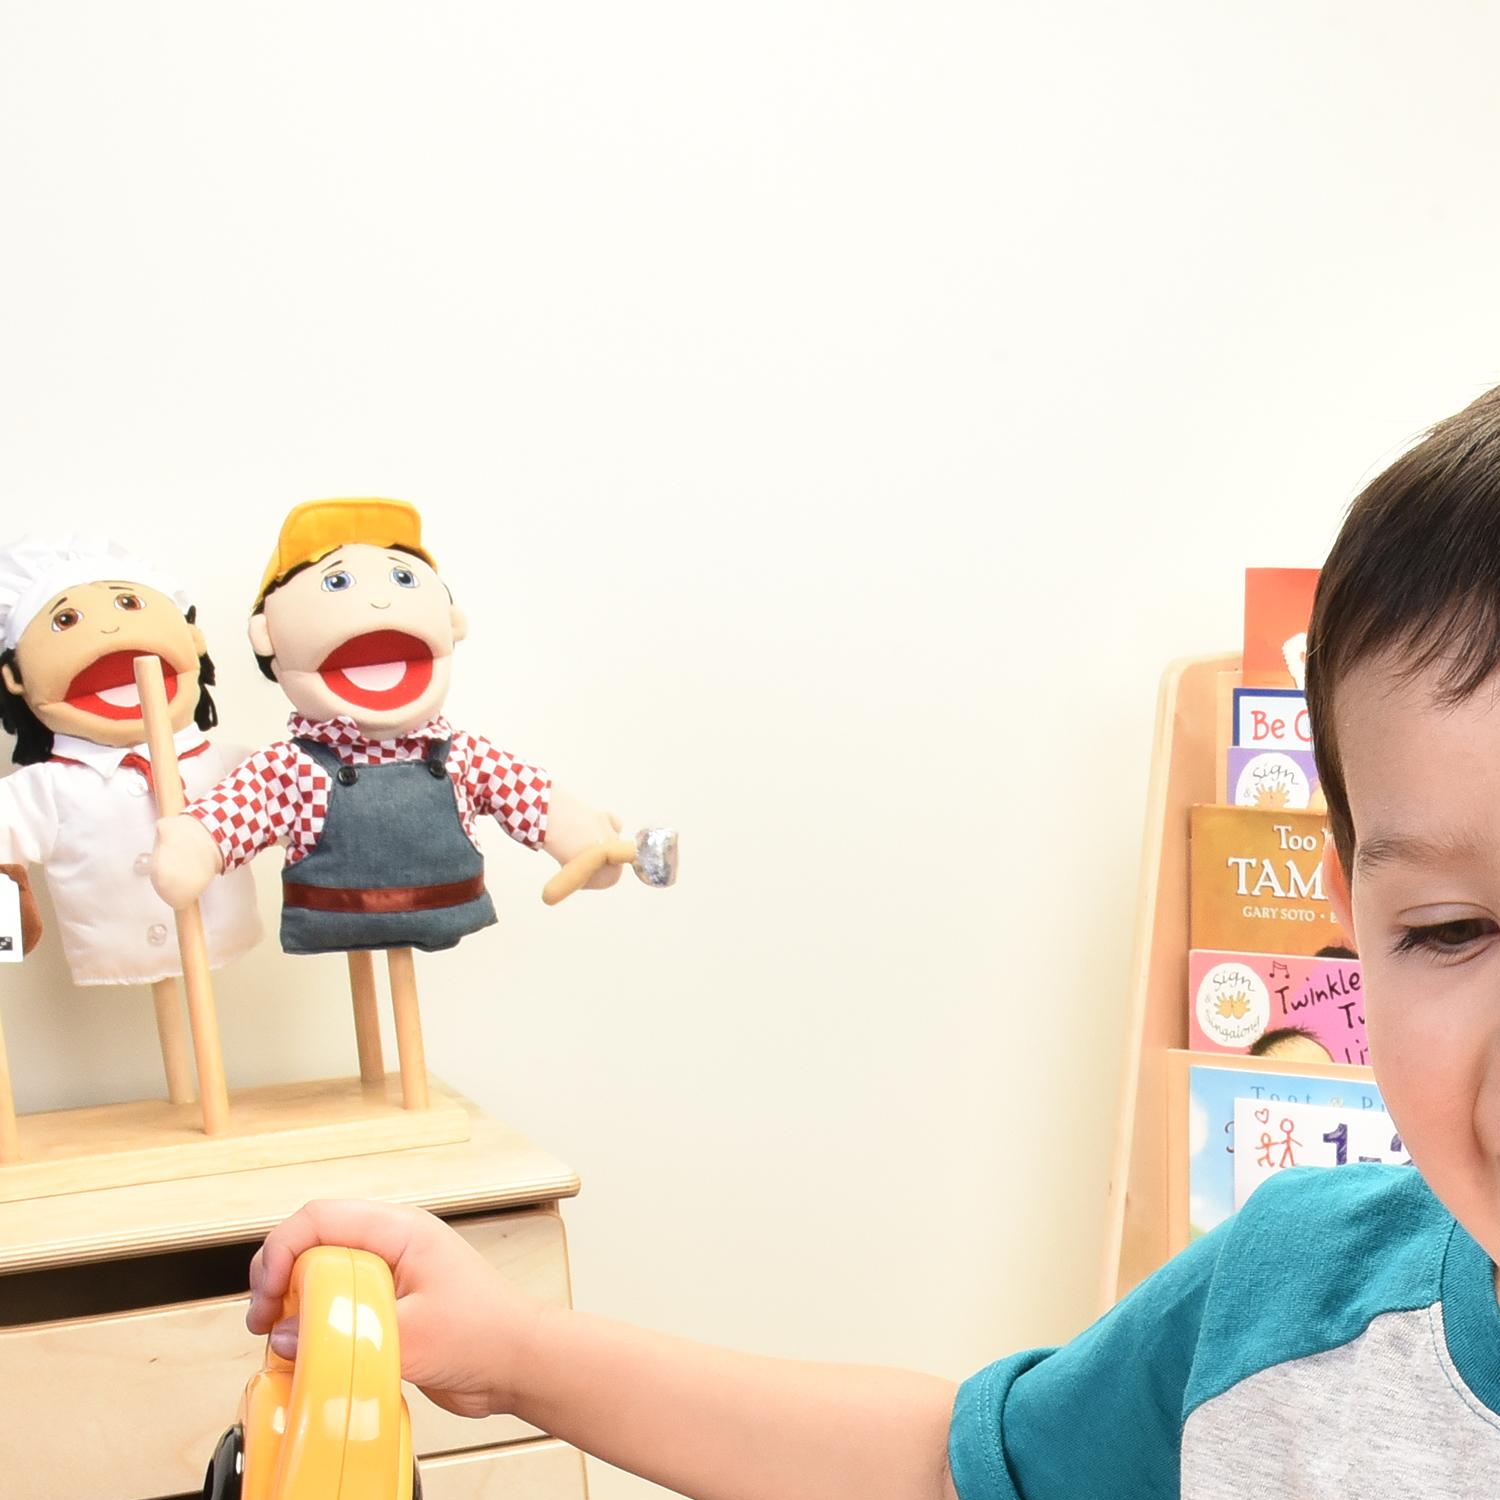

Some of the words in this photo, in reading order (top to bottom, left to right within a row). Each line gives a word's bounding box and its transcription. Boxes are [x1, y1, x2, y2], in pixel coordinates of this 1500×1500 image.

[1251, 710, 1285, 740] Be
[1273, 825, 1317, 851] Too
[1242, 905, 1278, 919] GARY
[1281, 907, 1315, 922] SOTO
[1274, 969, 1361, 1015] Twinkle
